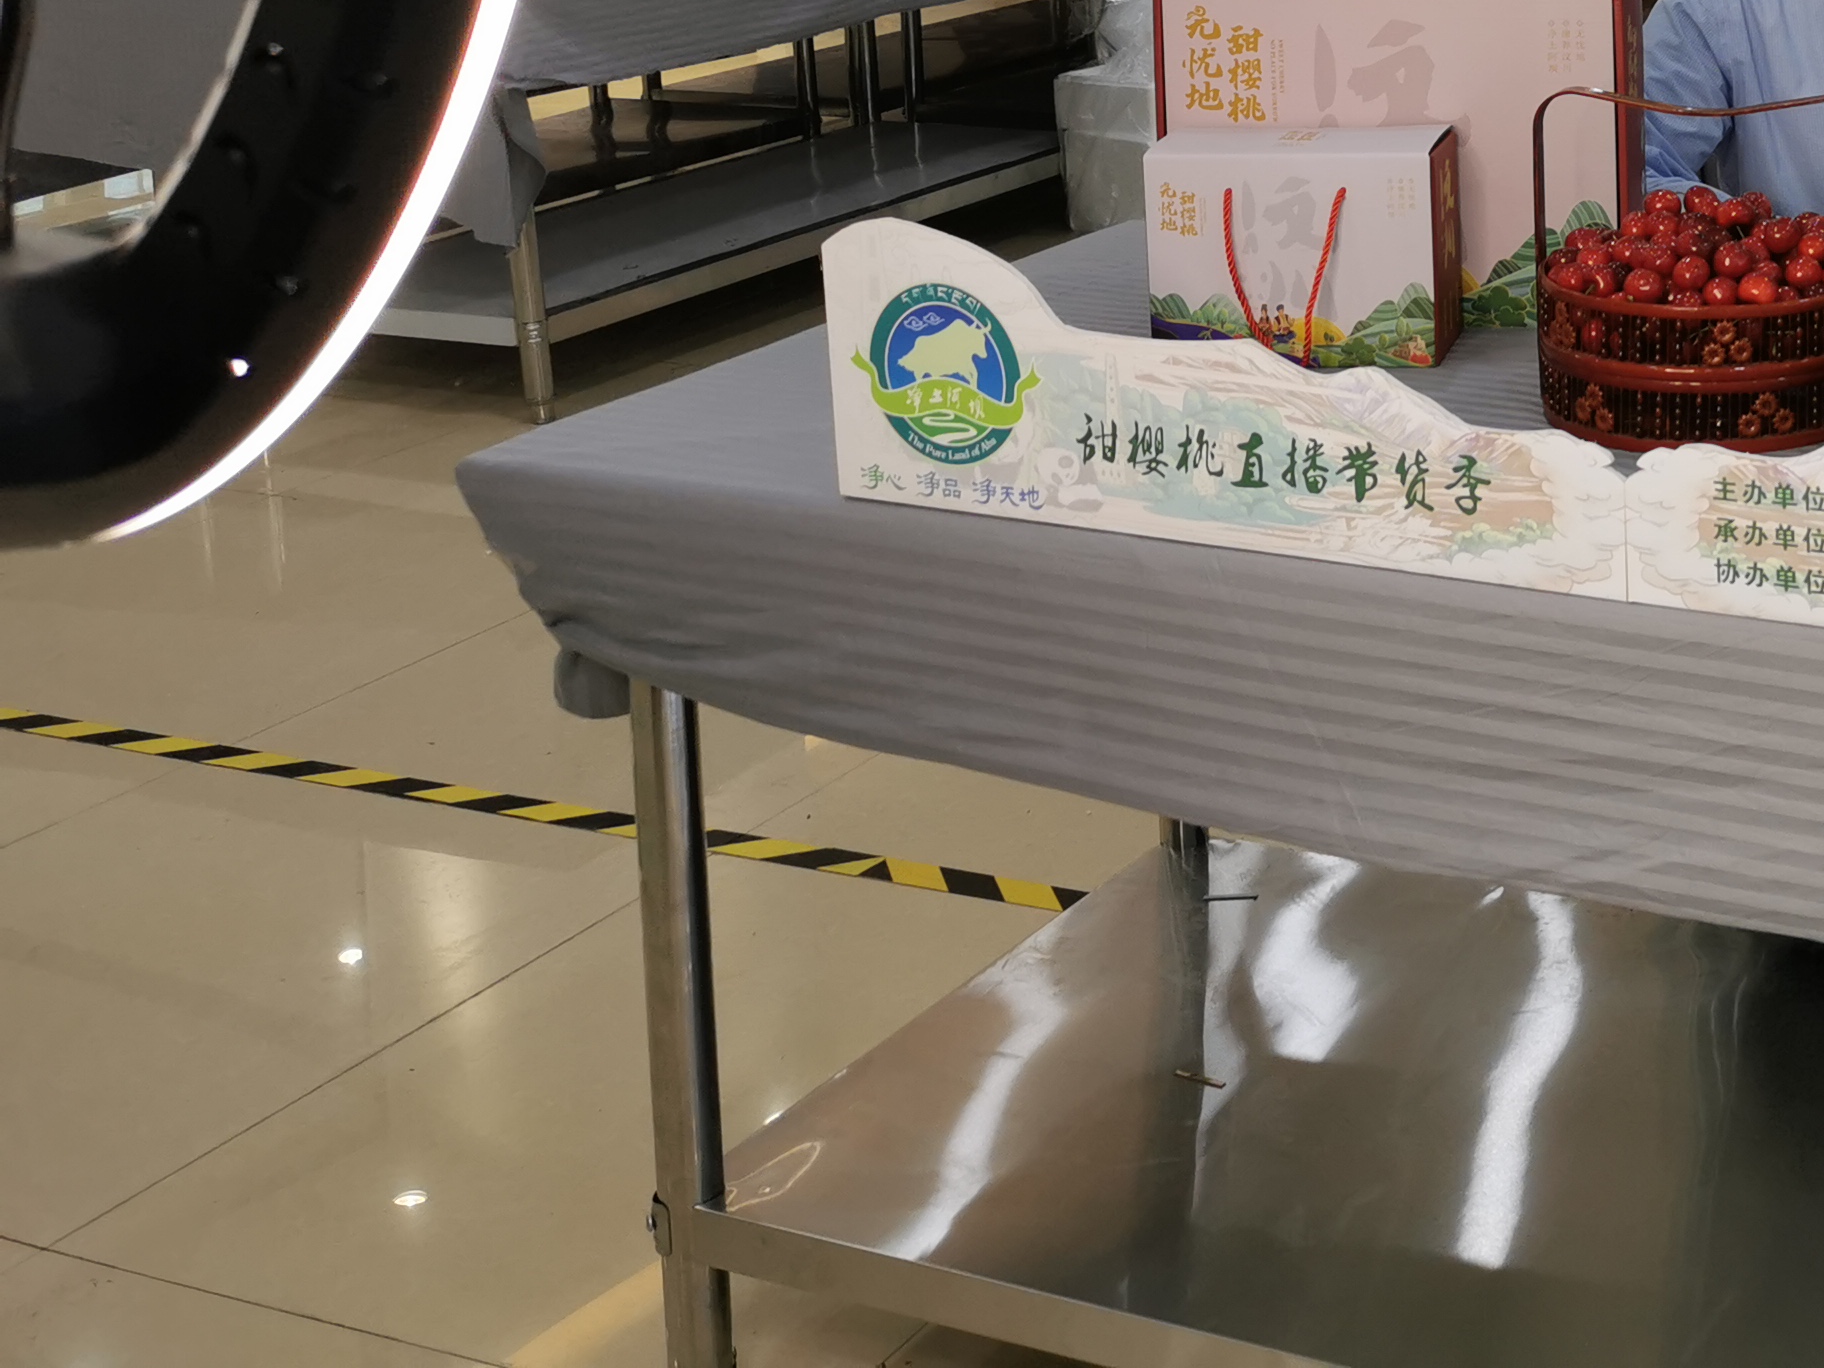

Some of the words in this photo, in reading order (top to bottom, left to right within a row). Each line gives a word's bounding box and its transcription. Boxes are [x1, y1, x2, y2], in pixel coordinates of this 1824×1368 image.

[1226, 25, 1267, 123] 甜樱桃
[907, 430, 924, 450] The
[925, 443, 947, 460] Pure
[948, 445, 970, 460] Land
[971, 443, 980, 457] of
